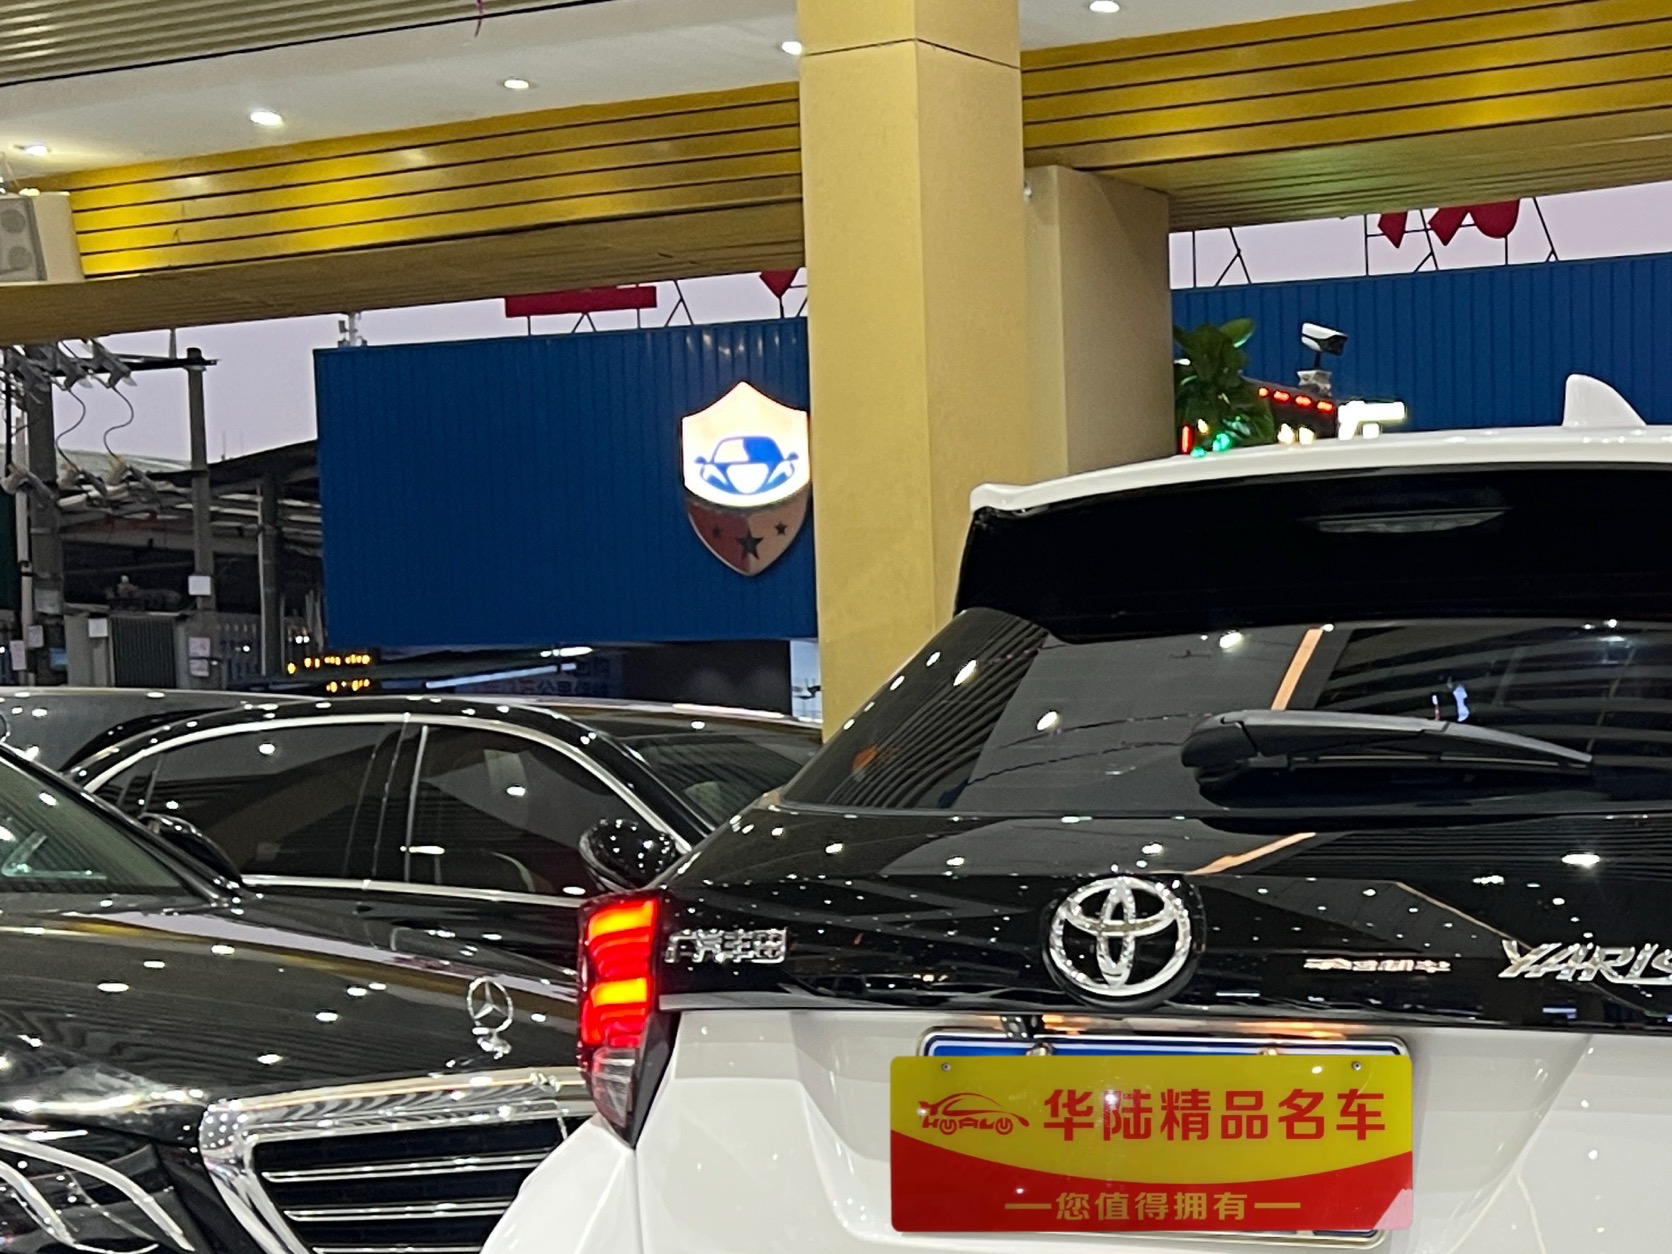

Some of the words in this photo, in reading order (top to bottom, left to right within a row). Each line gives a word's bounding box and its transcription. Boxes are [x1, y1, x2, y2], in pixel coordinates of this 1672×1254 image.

[665, 927, 788, 964] 广汽丰田
[1043, 1088, 1387, 1142] 华陆精品名车
[1055, 1191, 1248, 1222] 您值得拥有
